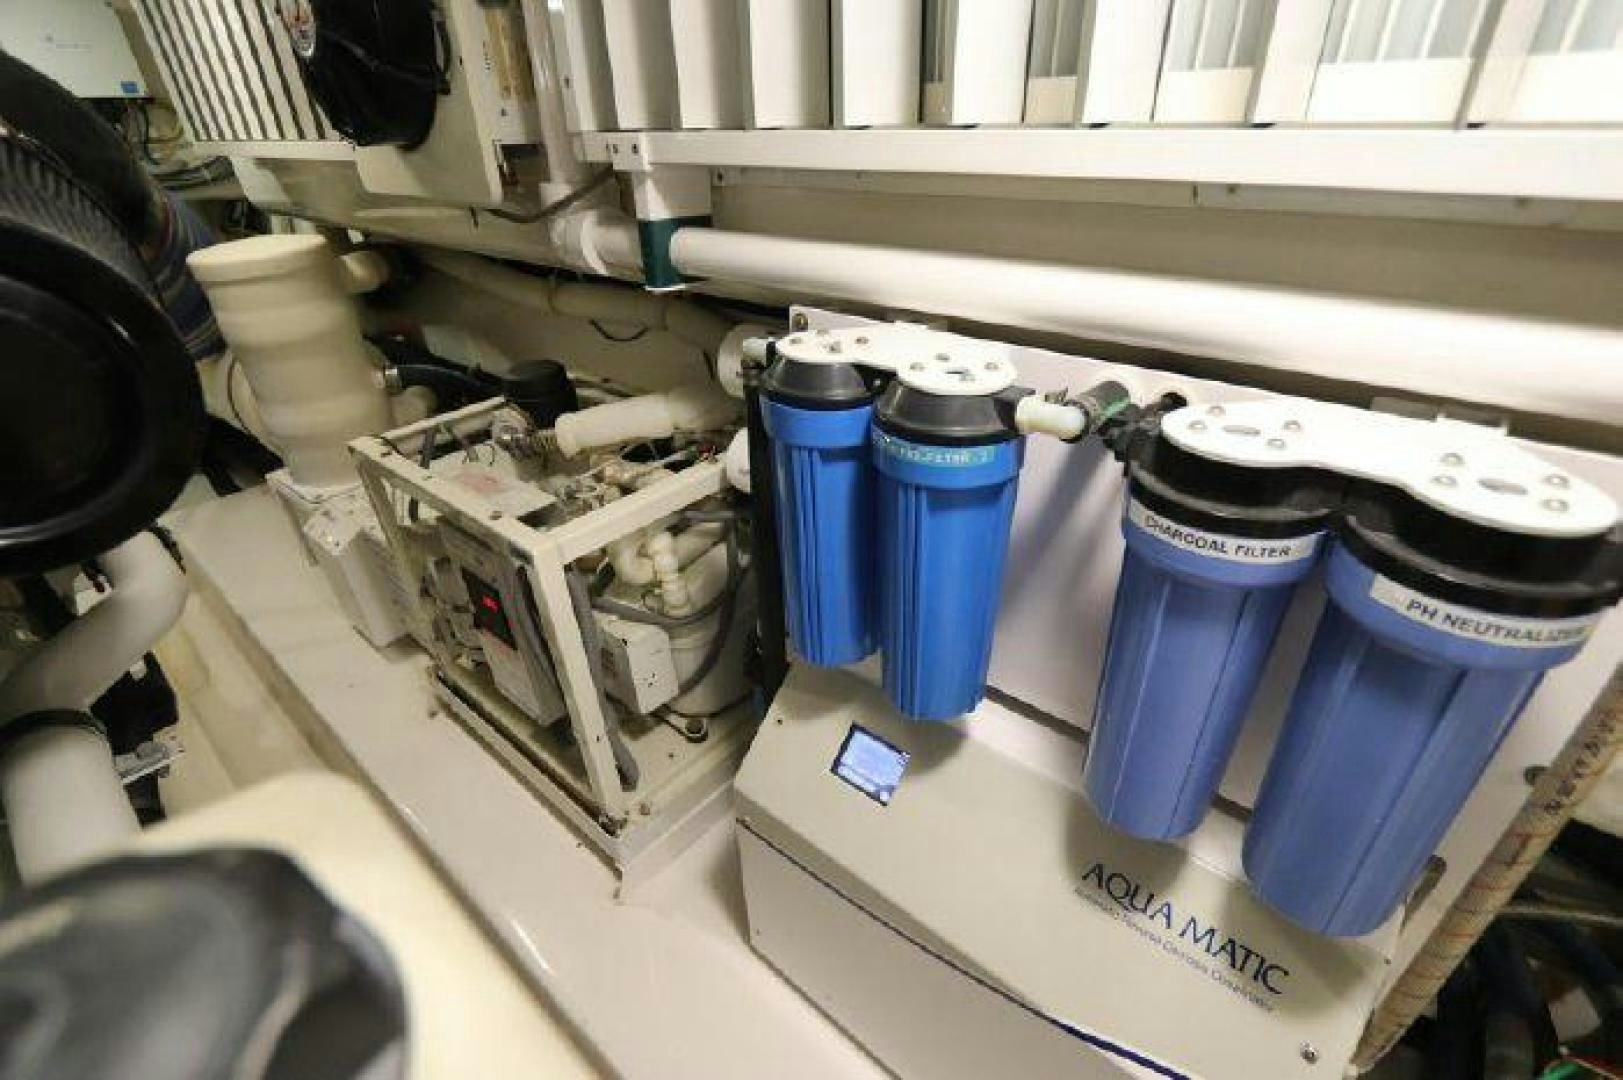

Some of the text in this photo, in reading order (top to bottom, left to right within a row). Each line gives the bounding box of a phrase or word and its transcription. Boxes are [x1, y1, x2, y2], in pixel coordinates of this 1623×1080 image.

[1145, 514, 1292, 558] CHARCOAL FILTER
[1405, 599, 1439, 621] PH
[1081, 863, 1171, 930] AQUA
[1178, 916, 1290, 995] MATIC
